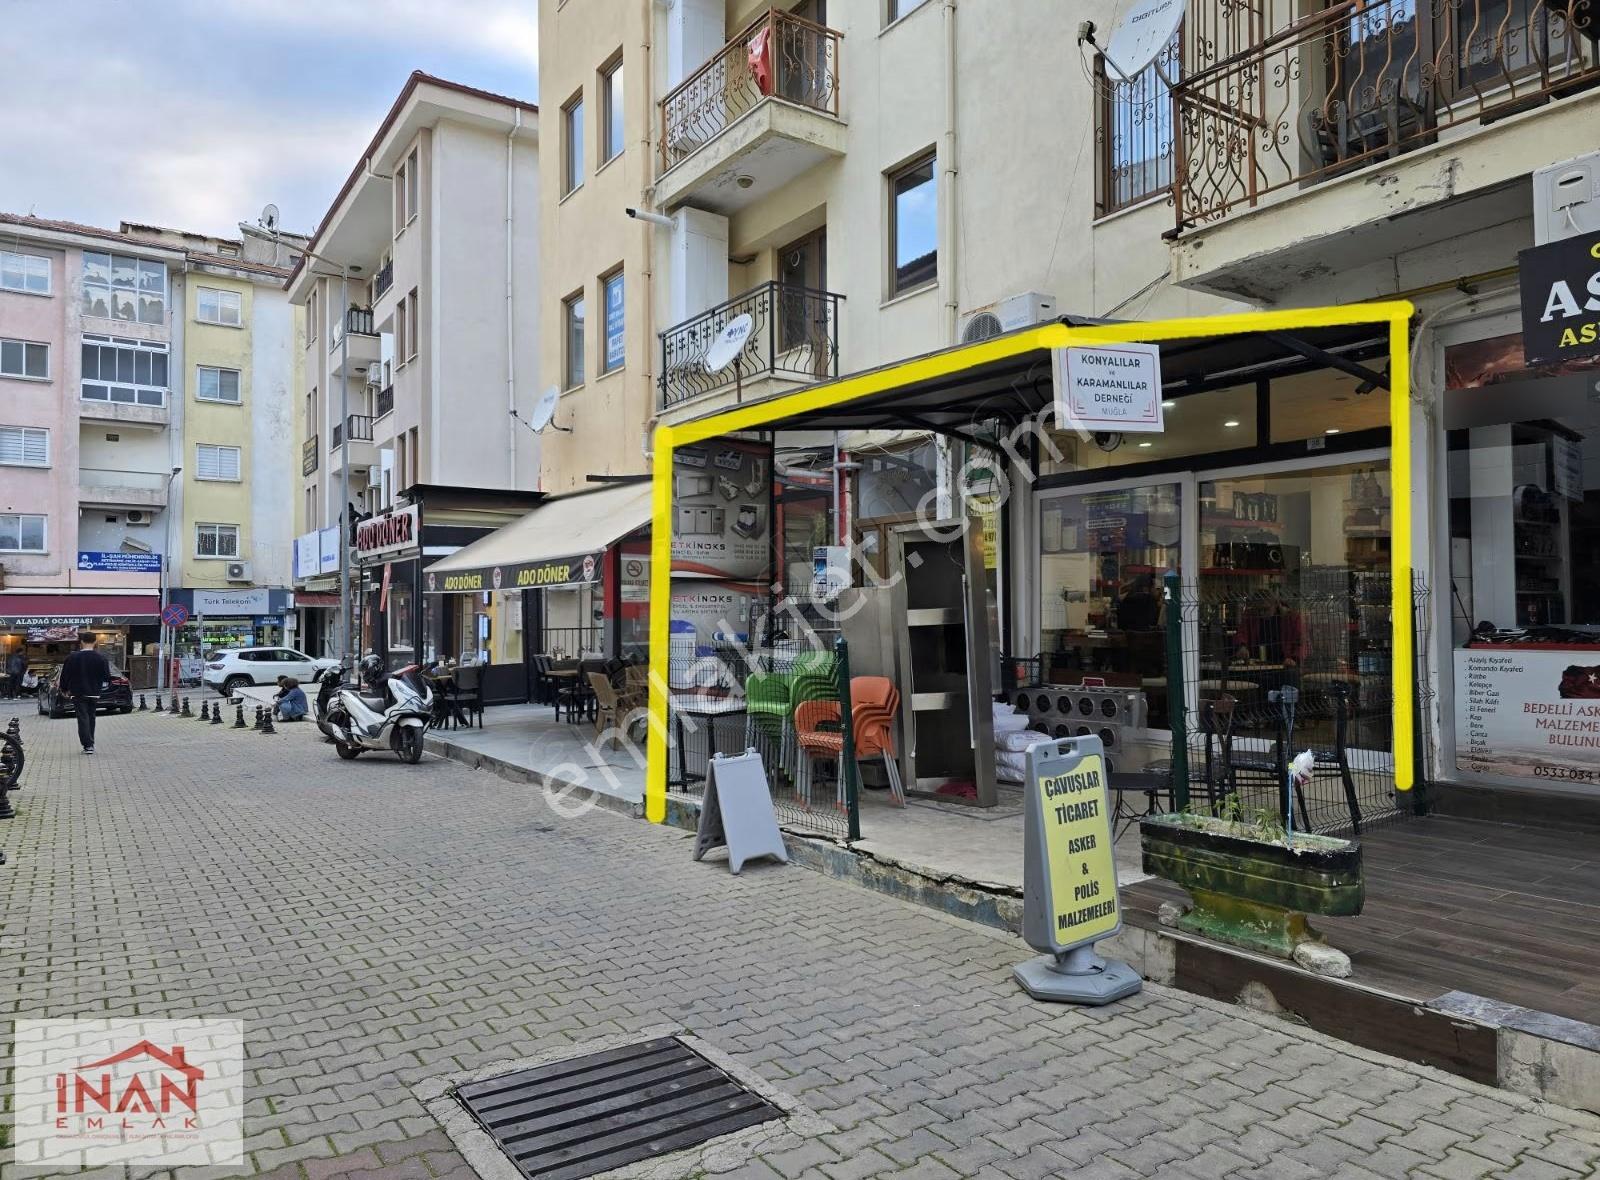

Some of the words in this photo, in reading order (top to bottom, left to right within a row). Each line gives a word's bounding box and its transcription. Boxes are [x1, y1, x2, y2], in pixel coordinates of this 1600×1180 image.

[1558, 322, 1600, 348] AS
[1081, 354, 1141, 369] KONYALILAR
[1077, 377, 1147, 392] KARAMANLILAR
[1094, 392, 1133, 404] DERNEĞİ
[1101, 406, 1128, 417] MUĞLA
[444, 576, 458, 590] ADO
[459, 574, 482, 589] DÖNER
[518, 570, 535, 586] ADO
[537, 564, 570, 583] DÖNER
[1524, 703, 1573, 715] BEDELLİ
[1536, 718, 1600, 732] MALZEME
[1534, 766, 1565, 778] 0533
[1569, 769, 1593, 780] 034
[1044, 770, 1100, 800] ÇAVUŞLAR
[1055, 799, 1099, 825] TİCARET
[1068, 834, 1096, 855] ASKER
[1082, 862, 1089, 875] &
[1074, 880, 1100, 901] POLİS
[1058, 899, 1115, 930] MALZEMELERİ
